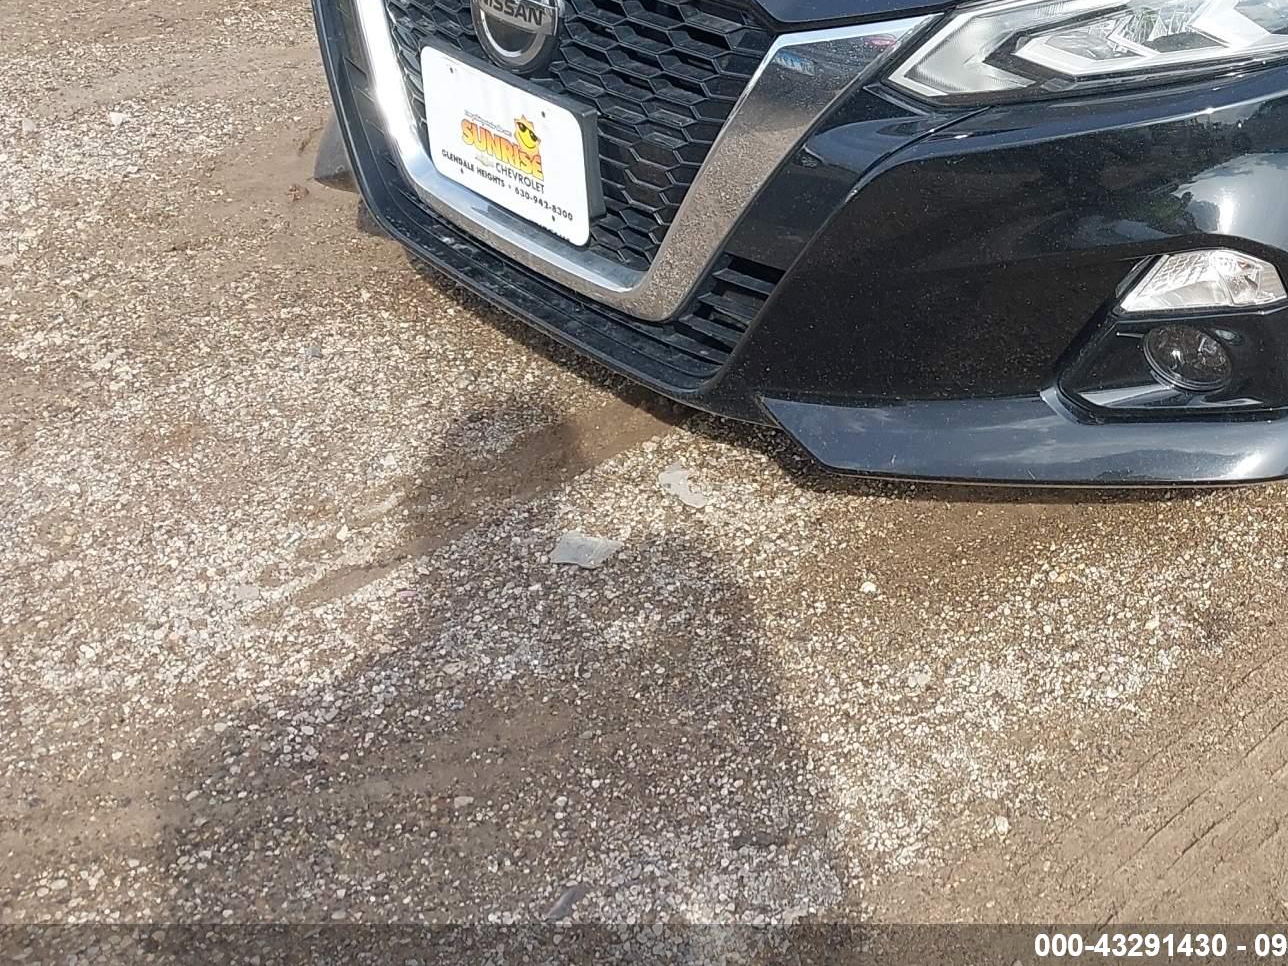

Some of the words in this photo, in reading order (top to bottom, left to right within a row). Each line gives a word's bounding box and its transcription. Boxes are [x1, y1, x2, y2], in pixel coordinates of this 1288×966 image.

[460, 117, 545, 182] SUNRISE
[495, 162, 545, 194] CHEVROLET
[441, 149, 475, 173] GLENDALE
[476, 168, 505, 188] HEIGHTS
[514, 186, 573, 221] 630-942-8300
